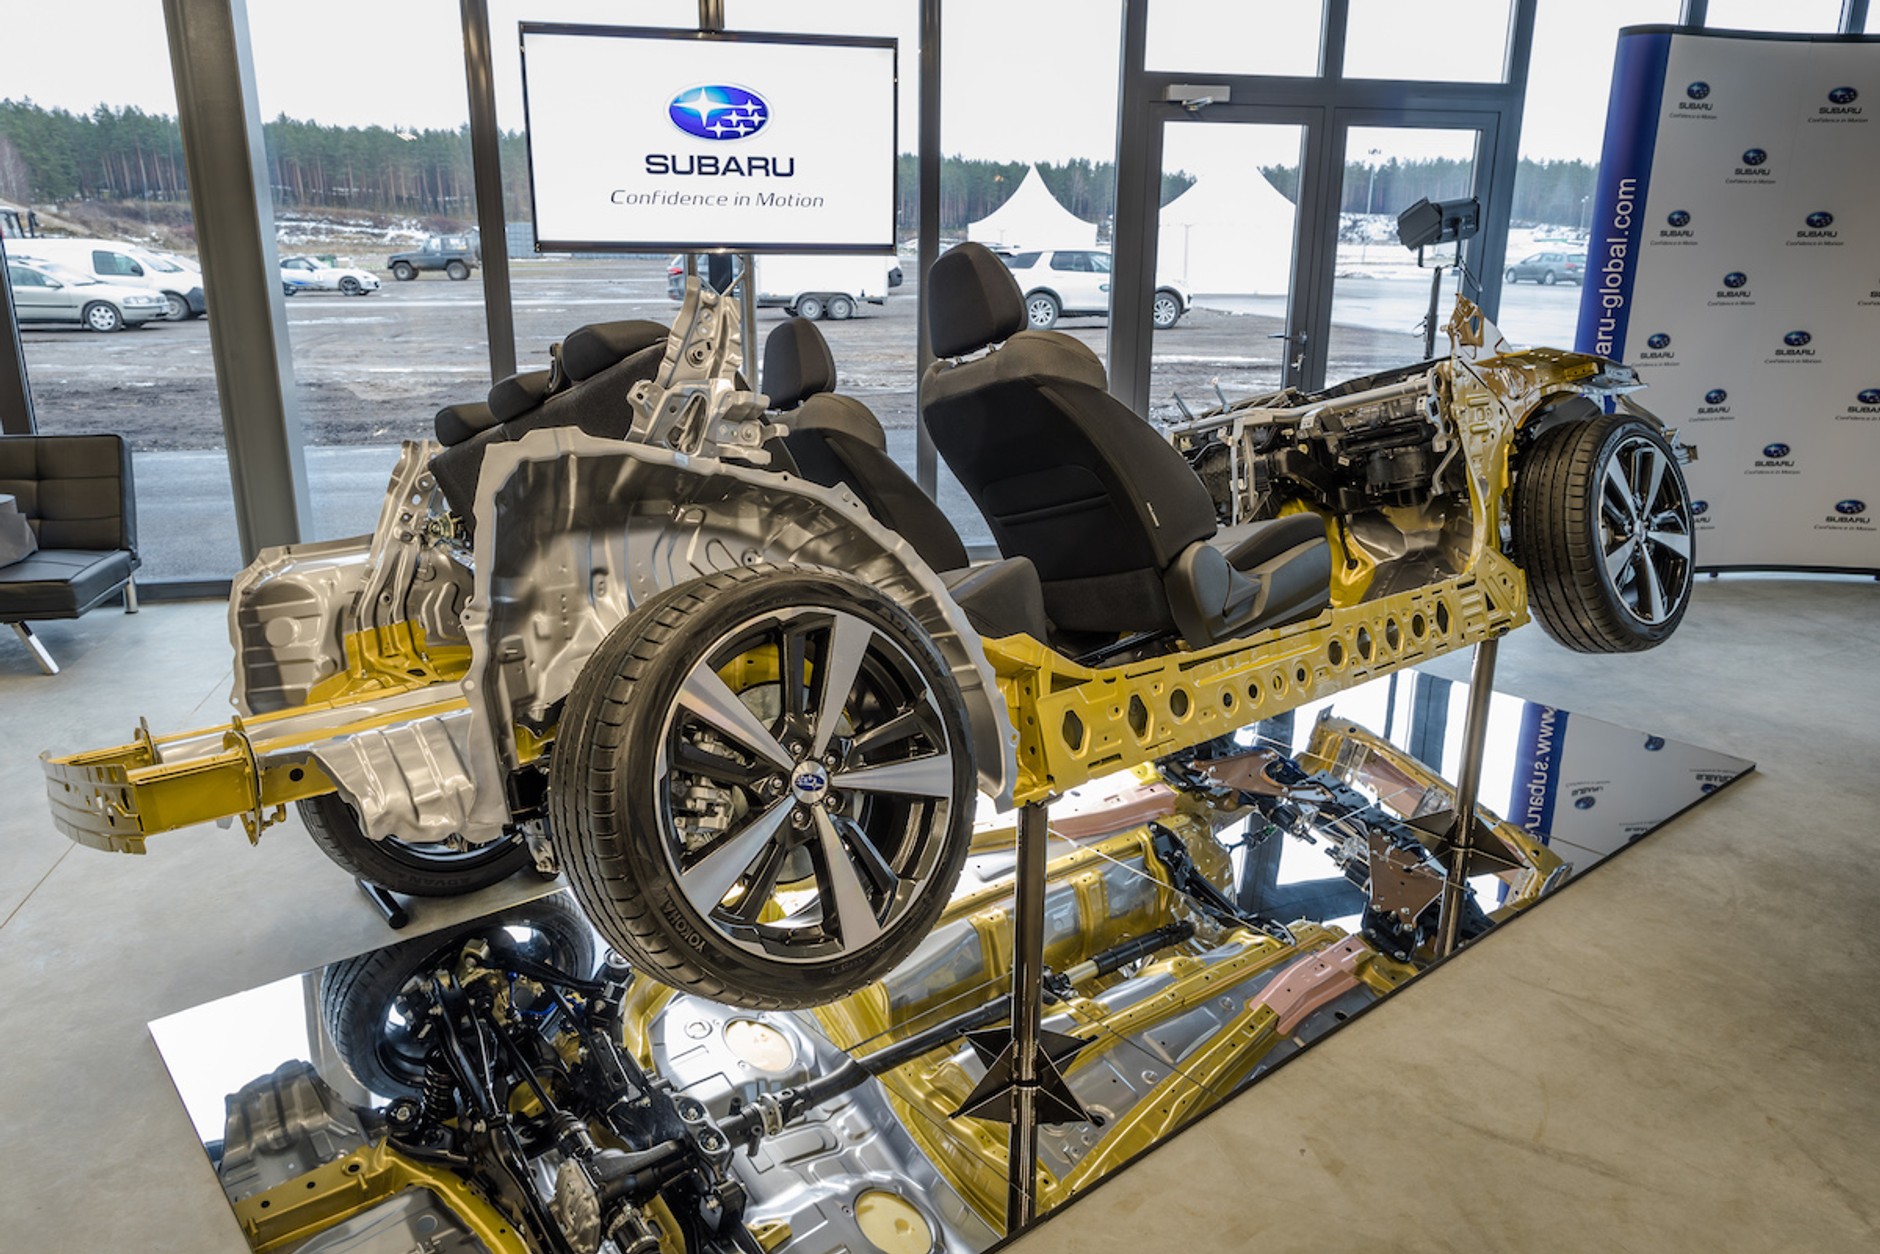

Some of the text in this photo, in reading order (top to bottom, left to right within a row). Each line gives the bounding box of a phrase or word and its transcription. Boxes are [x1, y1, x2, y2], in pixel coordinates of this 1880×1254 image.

[1678, 102, 1713, 111] SUBARU
[1818, 106, 1862, 114] SUBARU
[645, 154, 794, 177] SUBARU
[1734, 168, 1771, 176] SUBARU
[610, 189, 824, 208] Confidence in Motion
[1660, 230, 1694, 238] SUBARU
[1595, 178, 1637, 360] aru-global.com
[1825, 515, 1871, 524] SUBARU
